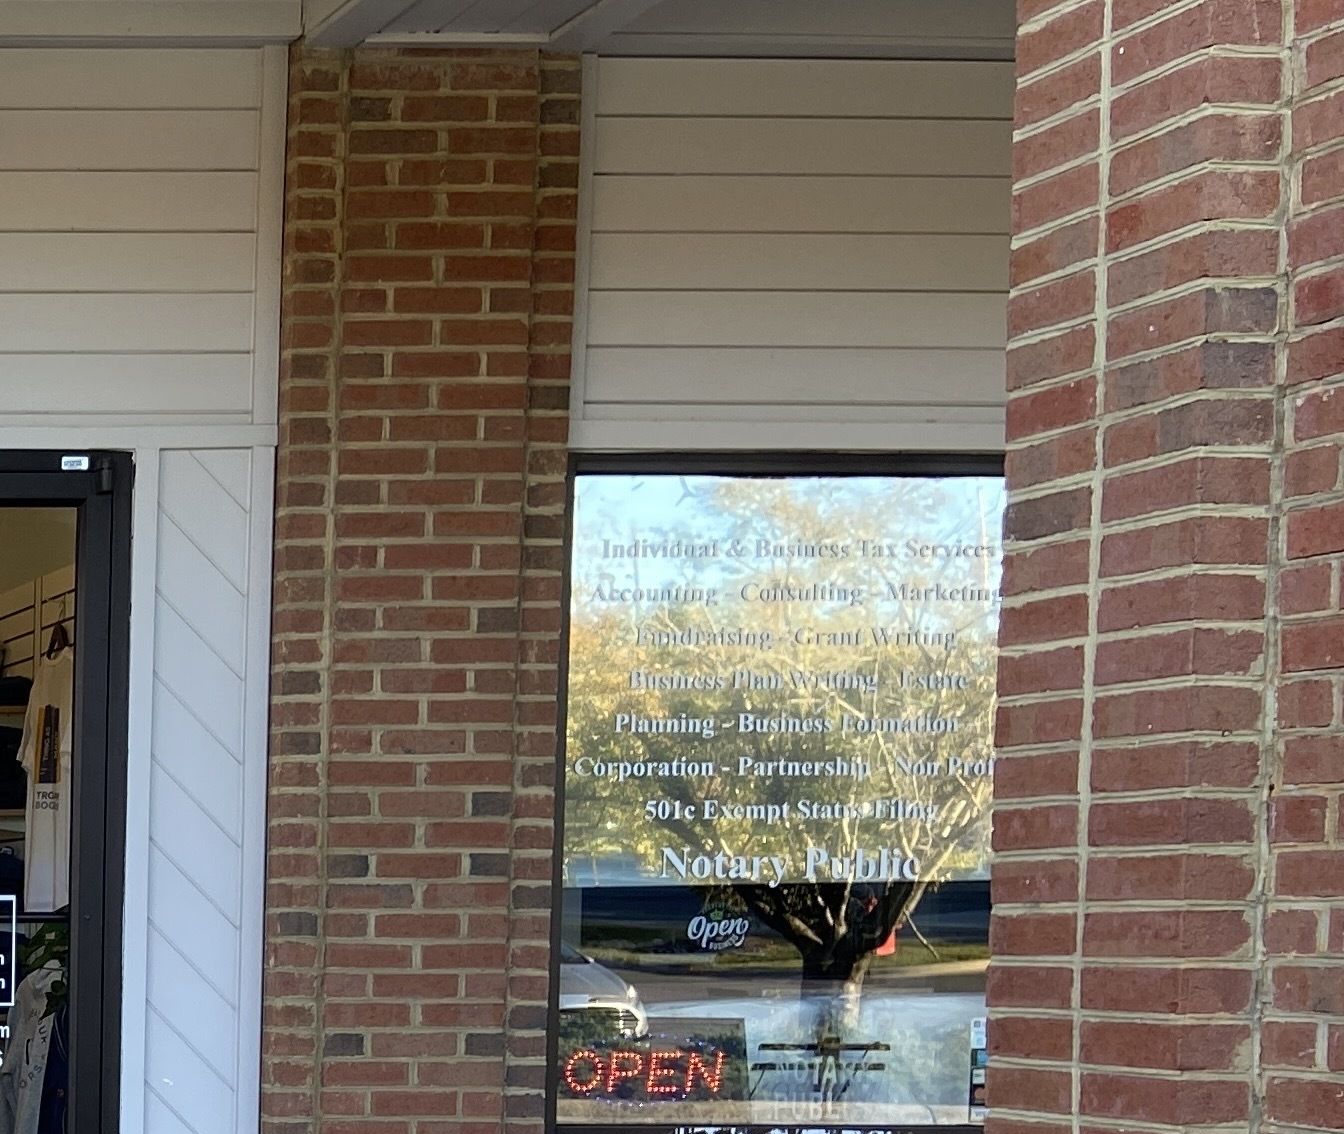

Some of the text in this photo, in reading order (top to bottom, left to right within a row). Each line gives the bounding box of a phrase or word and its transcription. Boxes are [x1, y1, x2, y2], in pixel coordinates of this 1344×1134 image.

[602, 539, 996, 559] Individual & Business Tax Services
[590, 583, 718, 607] Accounting
[740, 583, 864, 607] Consulting
[636, 627, 773, 651] Fundraising
[794, 627, 863, 647] Grant
[871, 627, 958, 651] Writing
[629, 670, 725, 690] Business
[732, 670, 784, 690] Plan
[789, 670, 879, 694] Writing
[900, 670, 969, 690] Estate
[614, 713, 715, 739] Planning
[738, 713, 833, 734] Business
[841, 714, 961, 733] Formation
[574, 756, 714, 782] Corporation
[737, 756, 871, 782] Partnership
[896, 756, 940, 776] Non
[645, 799, 939, 824] 501c Exempt Status Filing
[659, 846, 922, 888] Notary Public
[687, 916, 749, 948] Open
[565, 1051, 724, 1094] OPEN
